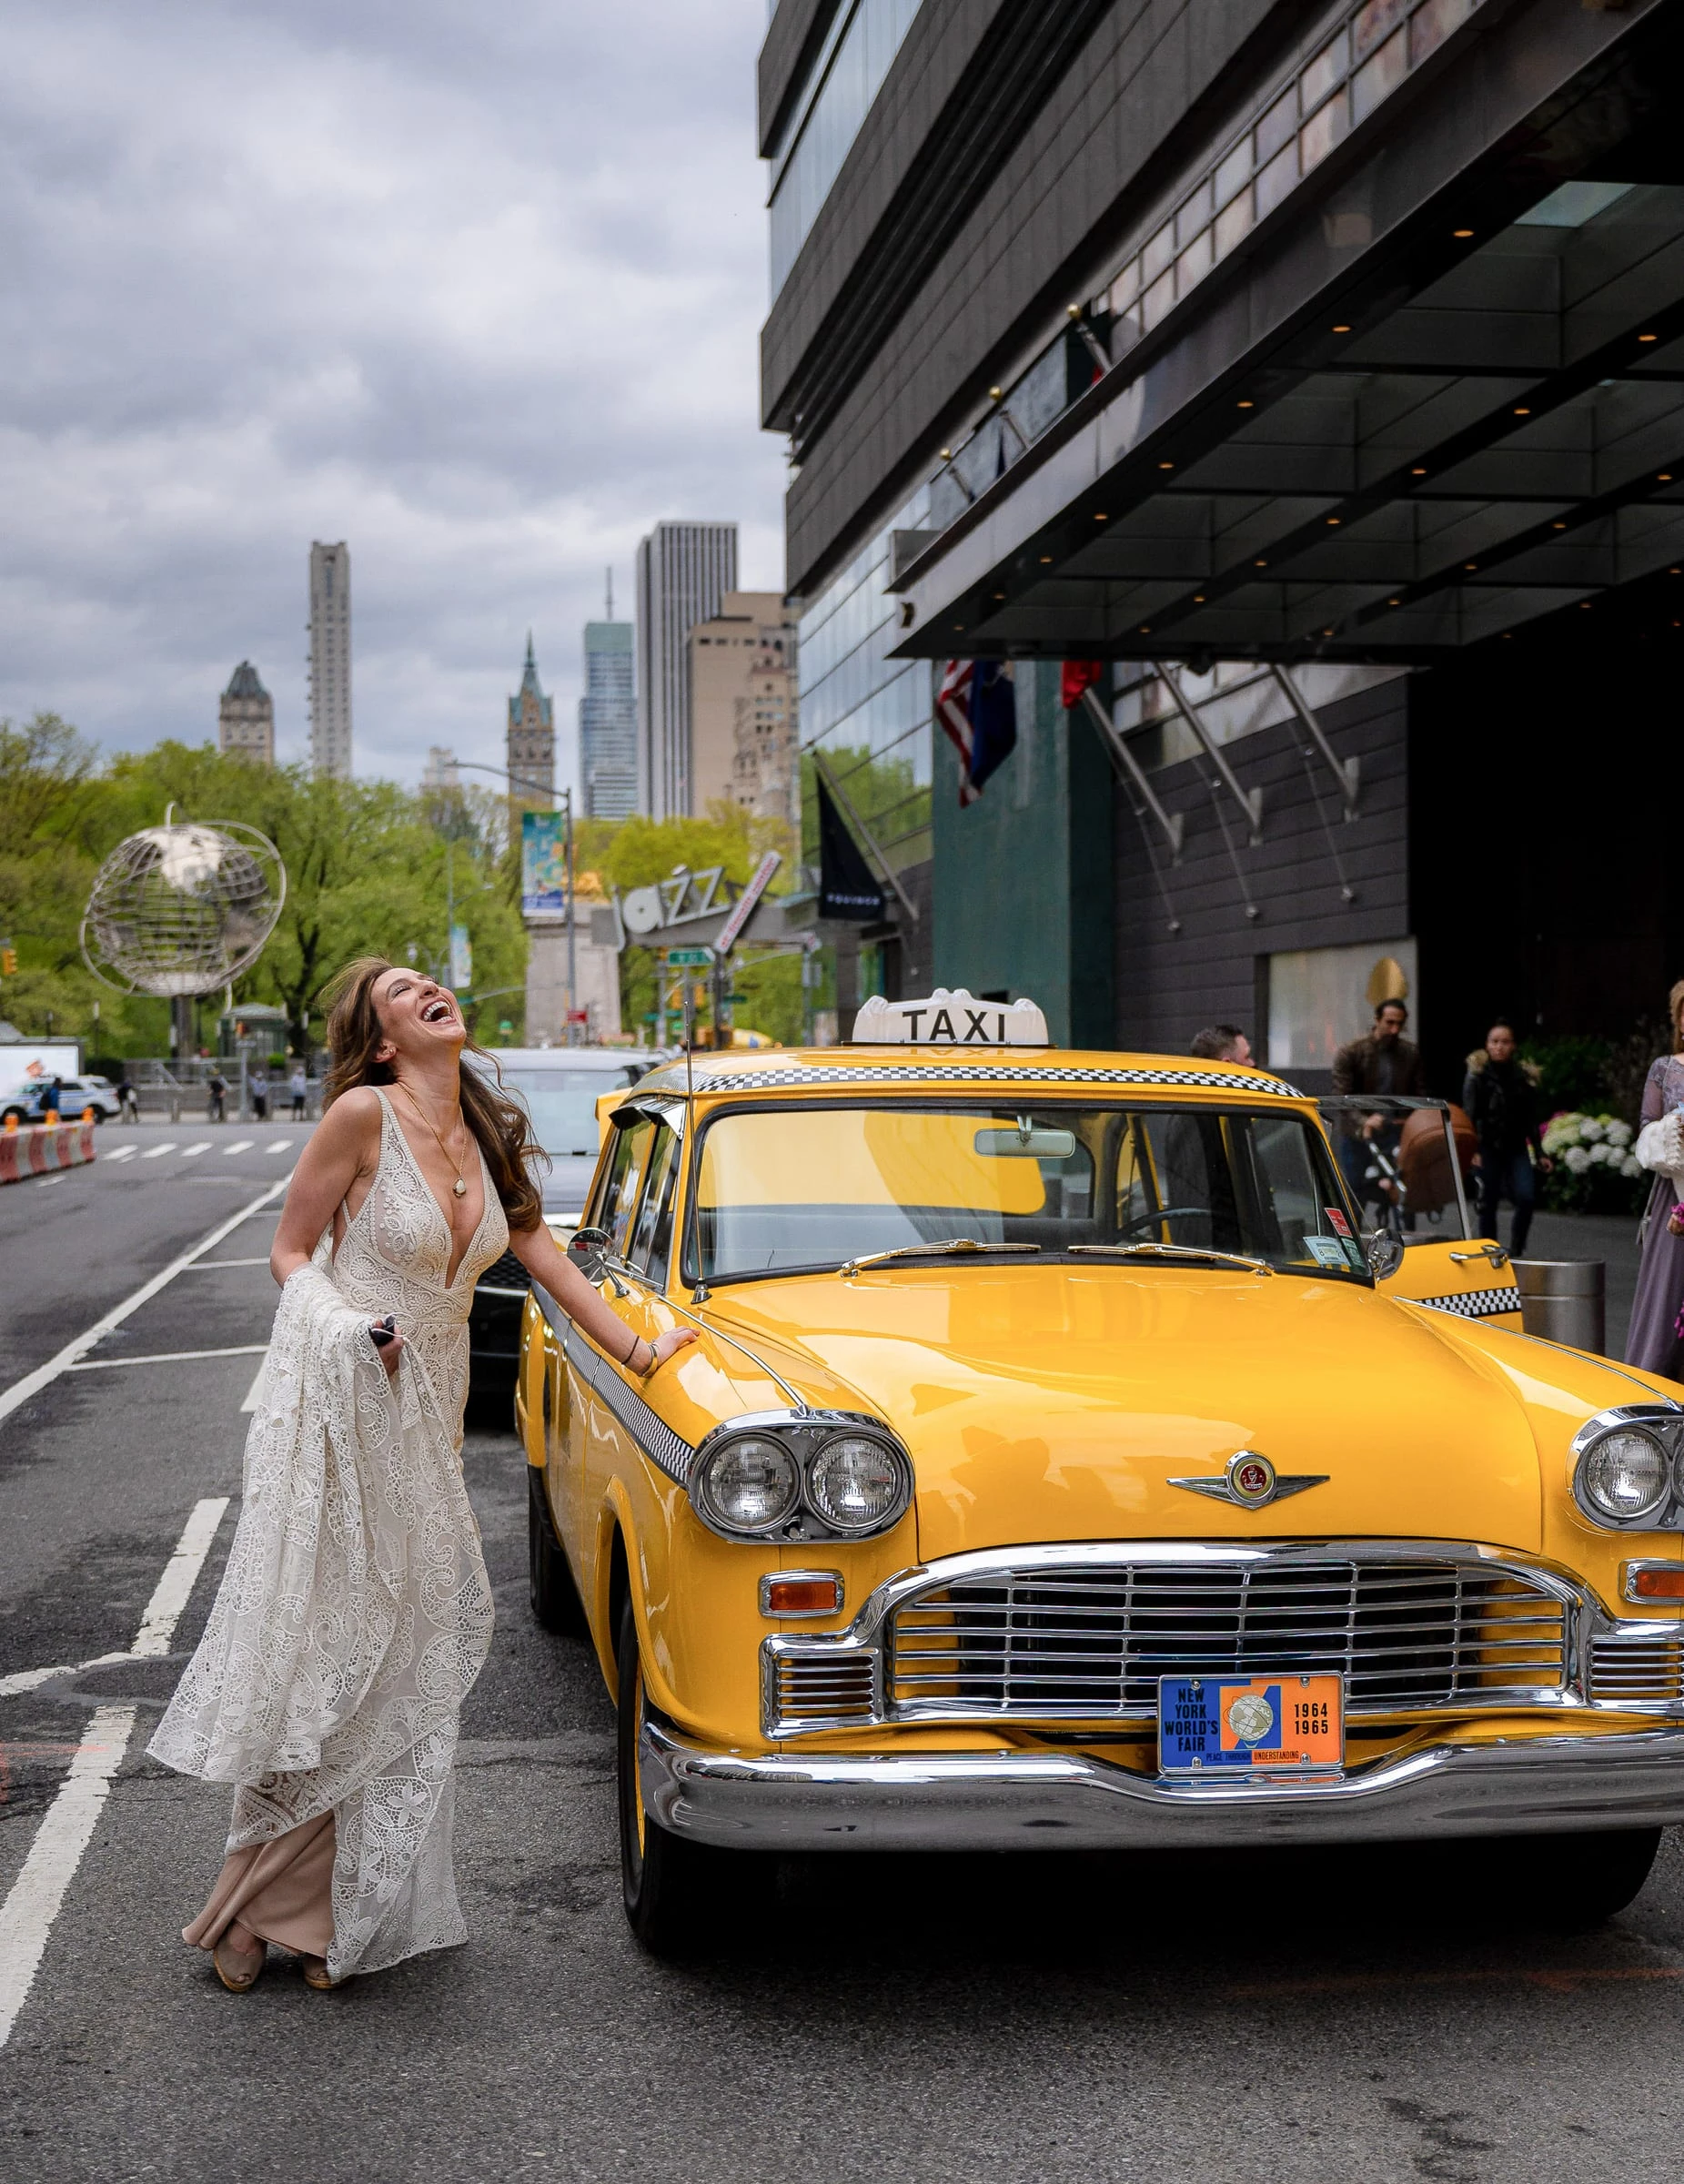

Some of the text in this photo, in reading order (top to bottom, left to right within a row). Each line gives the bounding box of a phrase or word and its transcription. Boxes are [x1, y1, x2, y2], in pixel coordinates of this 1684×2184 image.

[903, 1008, 1005, 1042] TAXI
[1177, 1688, 1205, 1703] NEW
[1175, 1704, 1207, 1719] YORK
[1294, 1703, 1328, 1718] 1964
[1165, 1720, 1219, 1735] WORLD'S
[1295, 1719, 1328, 1734] 1965
[1177, 1736, 1205, 1752] FAIR
[1254, 1750, 1299, 1760] UNDERSTANDING
